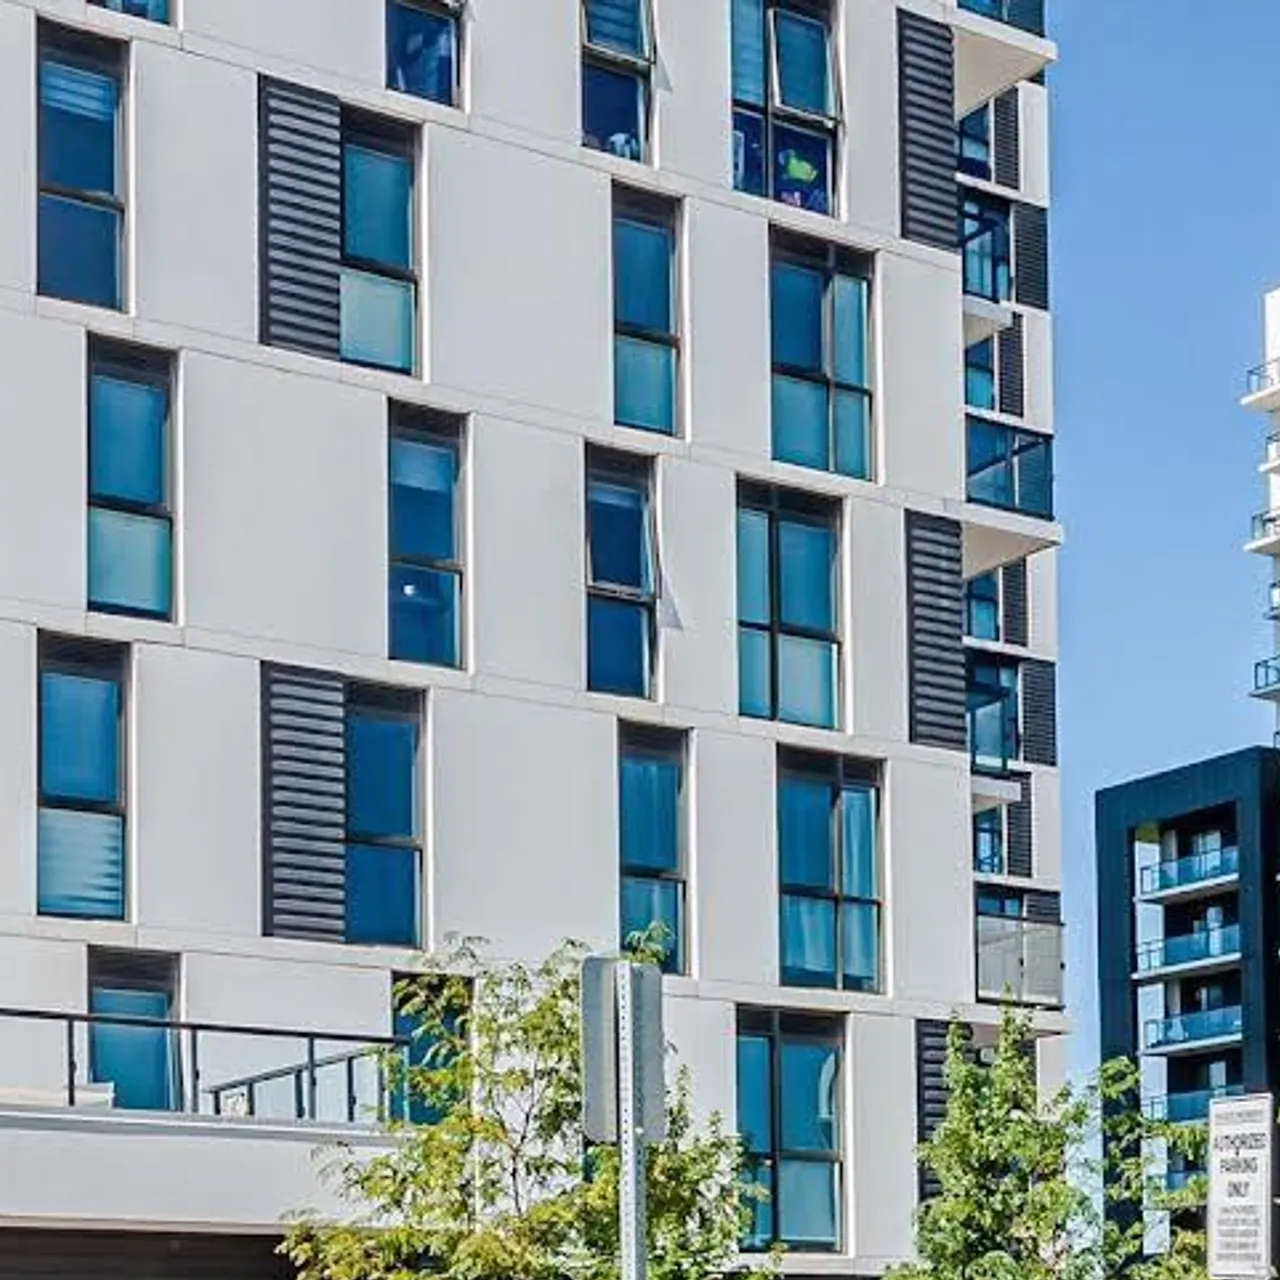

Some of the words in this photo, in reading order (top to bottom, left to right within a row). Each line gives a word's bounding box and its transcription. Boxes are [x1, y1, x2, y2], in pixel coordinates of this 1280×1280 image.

[1214, 1132, 1266, 1152] AUTHORIZED
[1220, 1157, 1258, 1174] PARKING
[1228, 1180, 1250, 1199] ONLY
